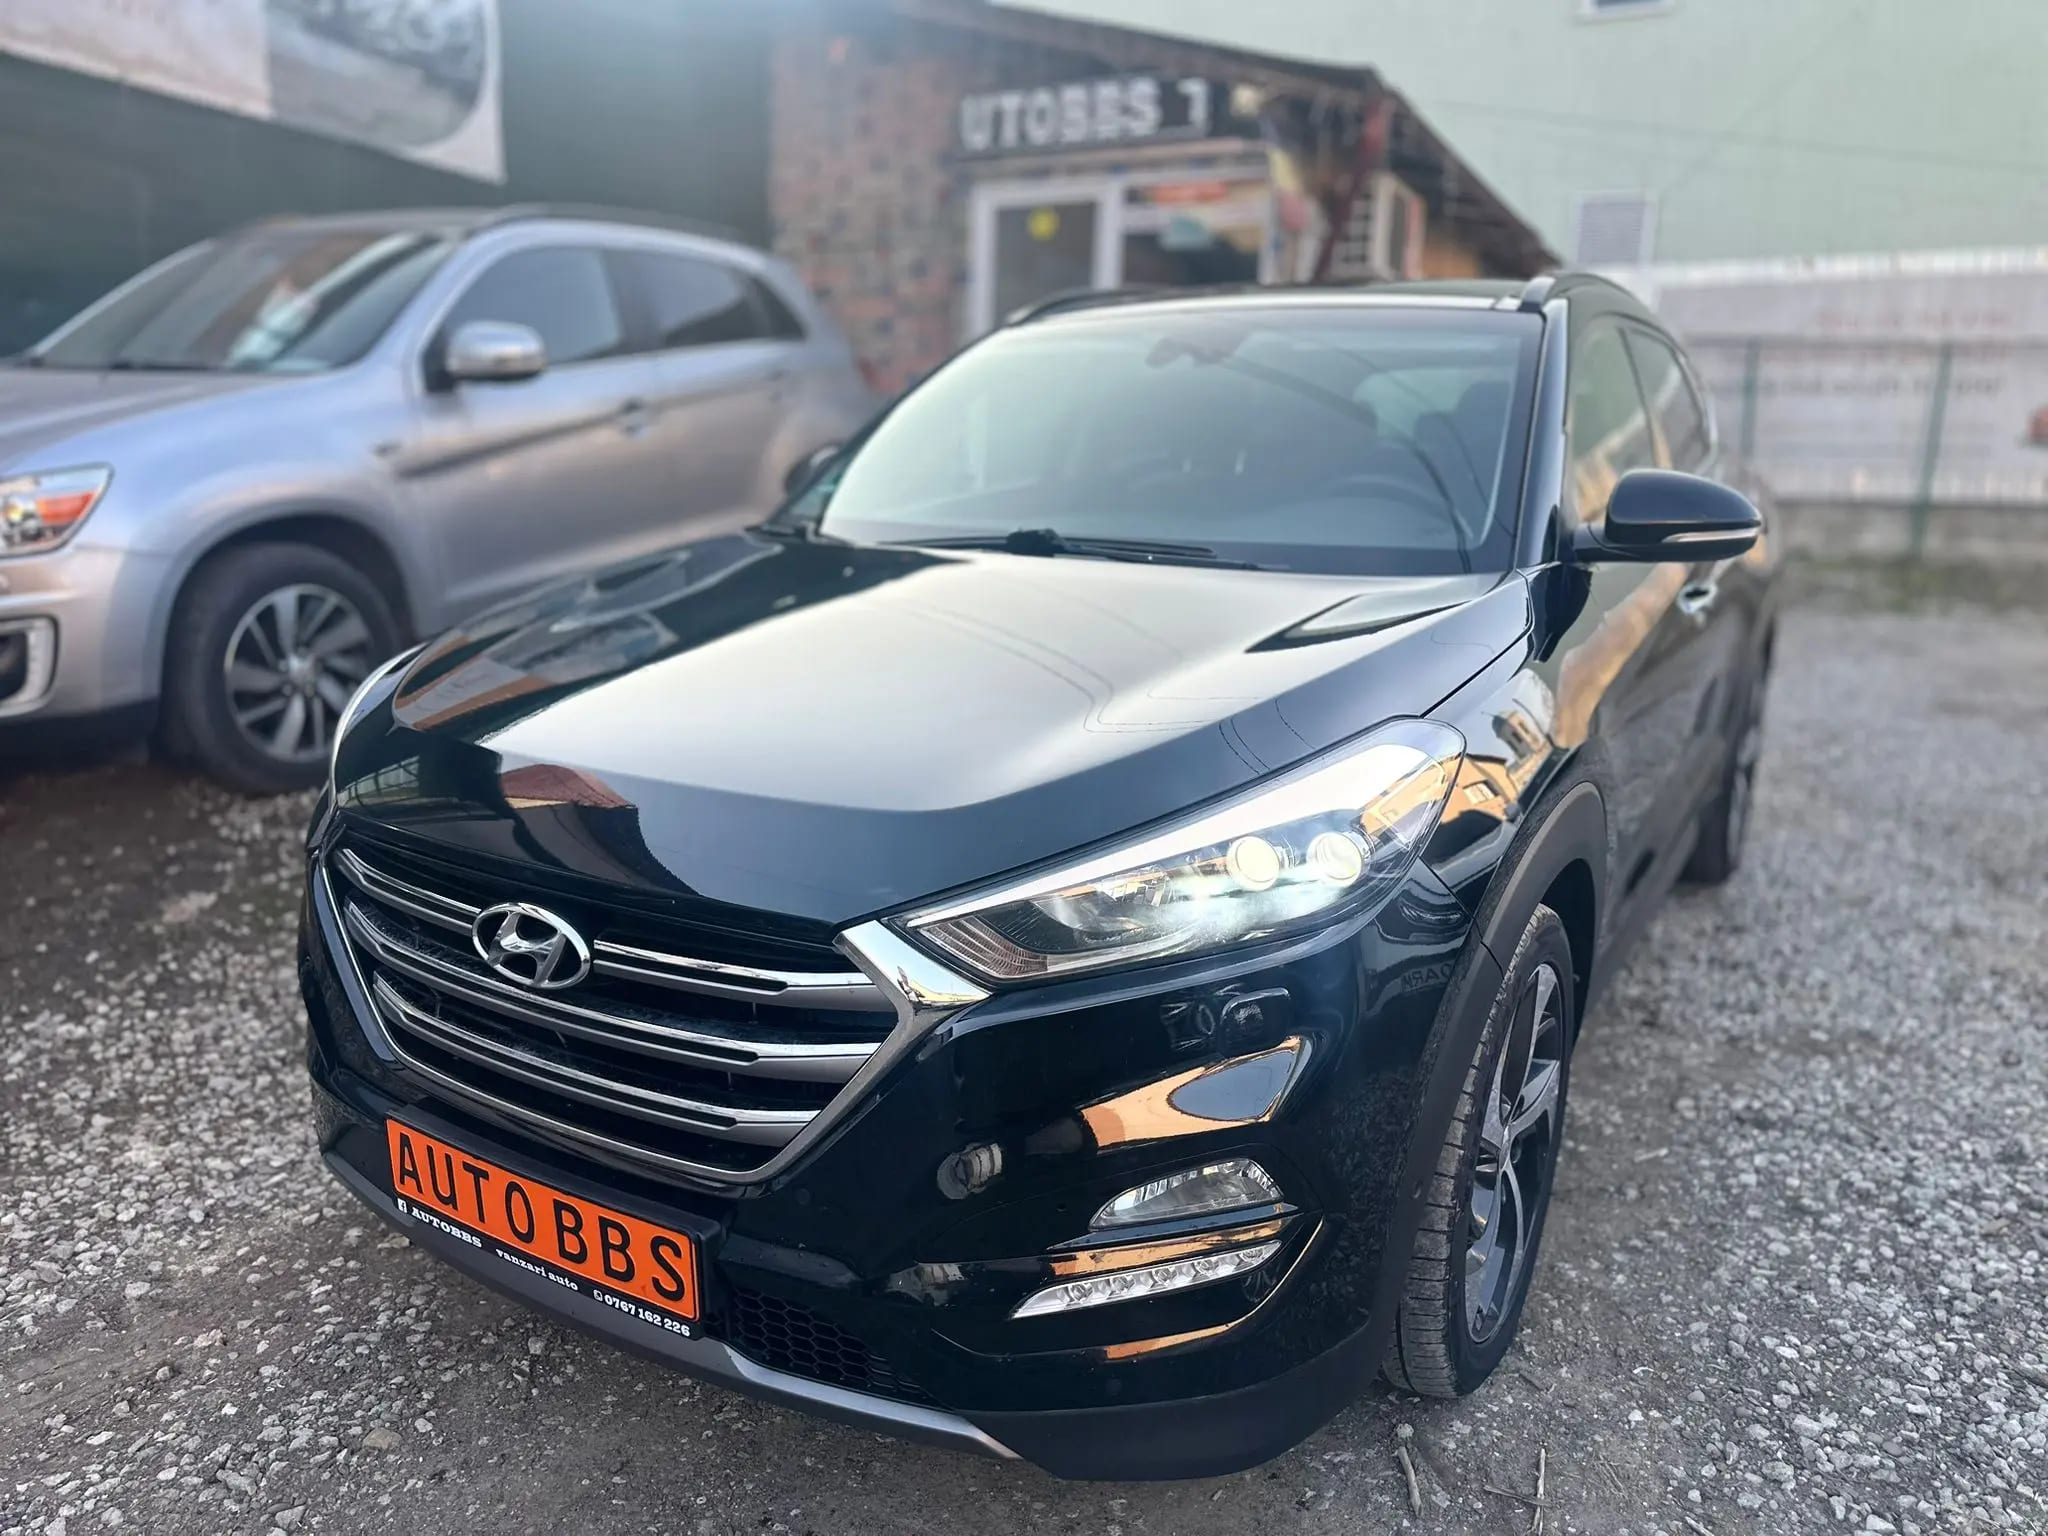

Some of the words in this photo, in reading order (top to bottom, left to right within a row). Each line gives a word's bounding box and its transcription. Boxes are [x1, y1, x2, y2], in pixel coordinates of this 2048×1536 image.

[399, 1132, 535, 1244] AUTO
[552, 1198, 685, 1301] BBS
[411, 1206, 482, 1248] AUTOBBS
[495, 1248, 547, 1277] vanzari
[548, 1273, 579, 1291] auto
[604, 1294, 636, 1315] 0767
[638, 1308, 662, 1326] 162
[664, 1318, 690, 1337] 226
